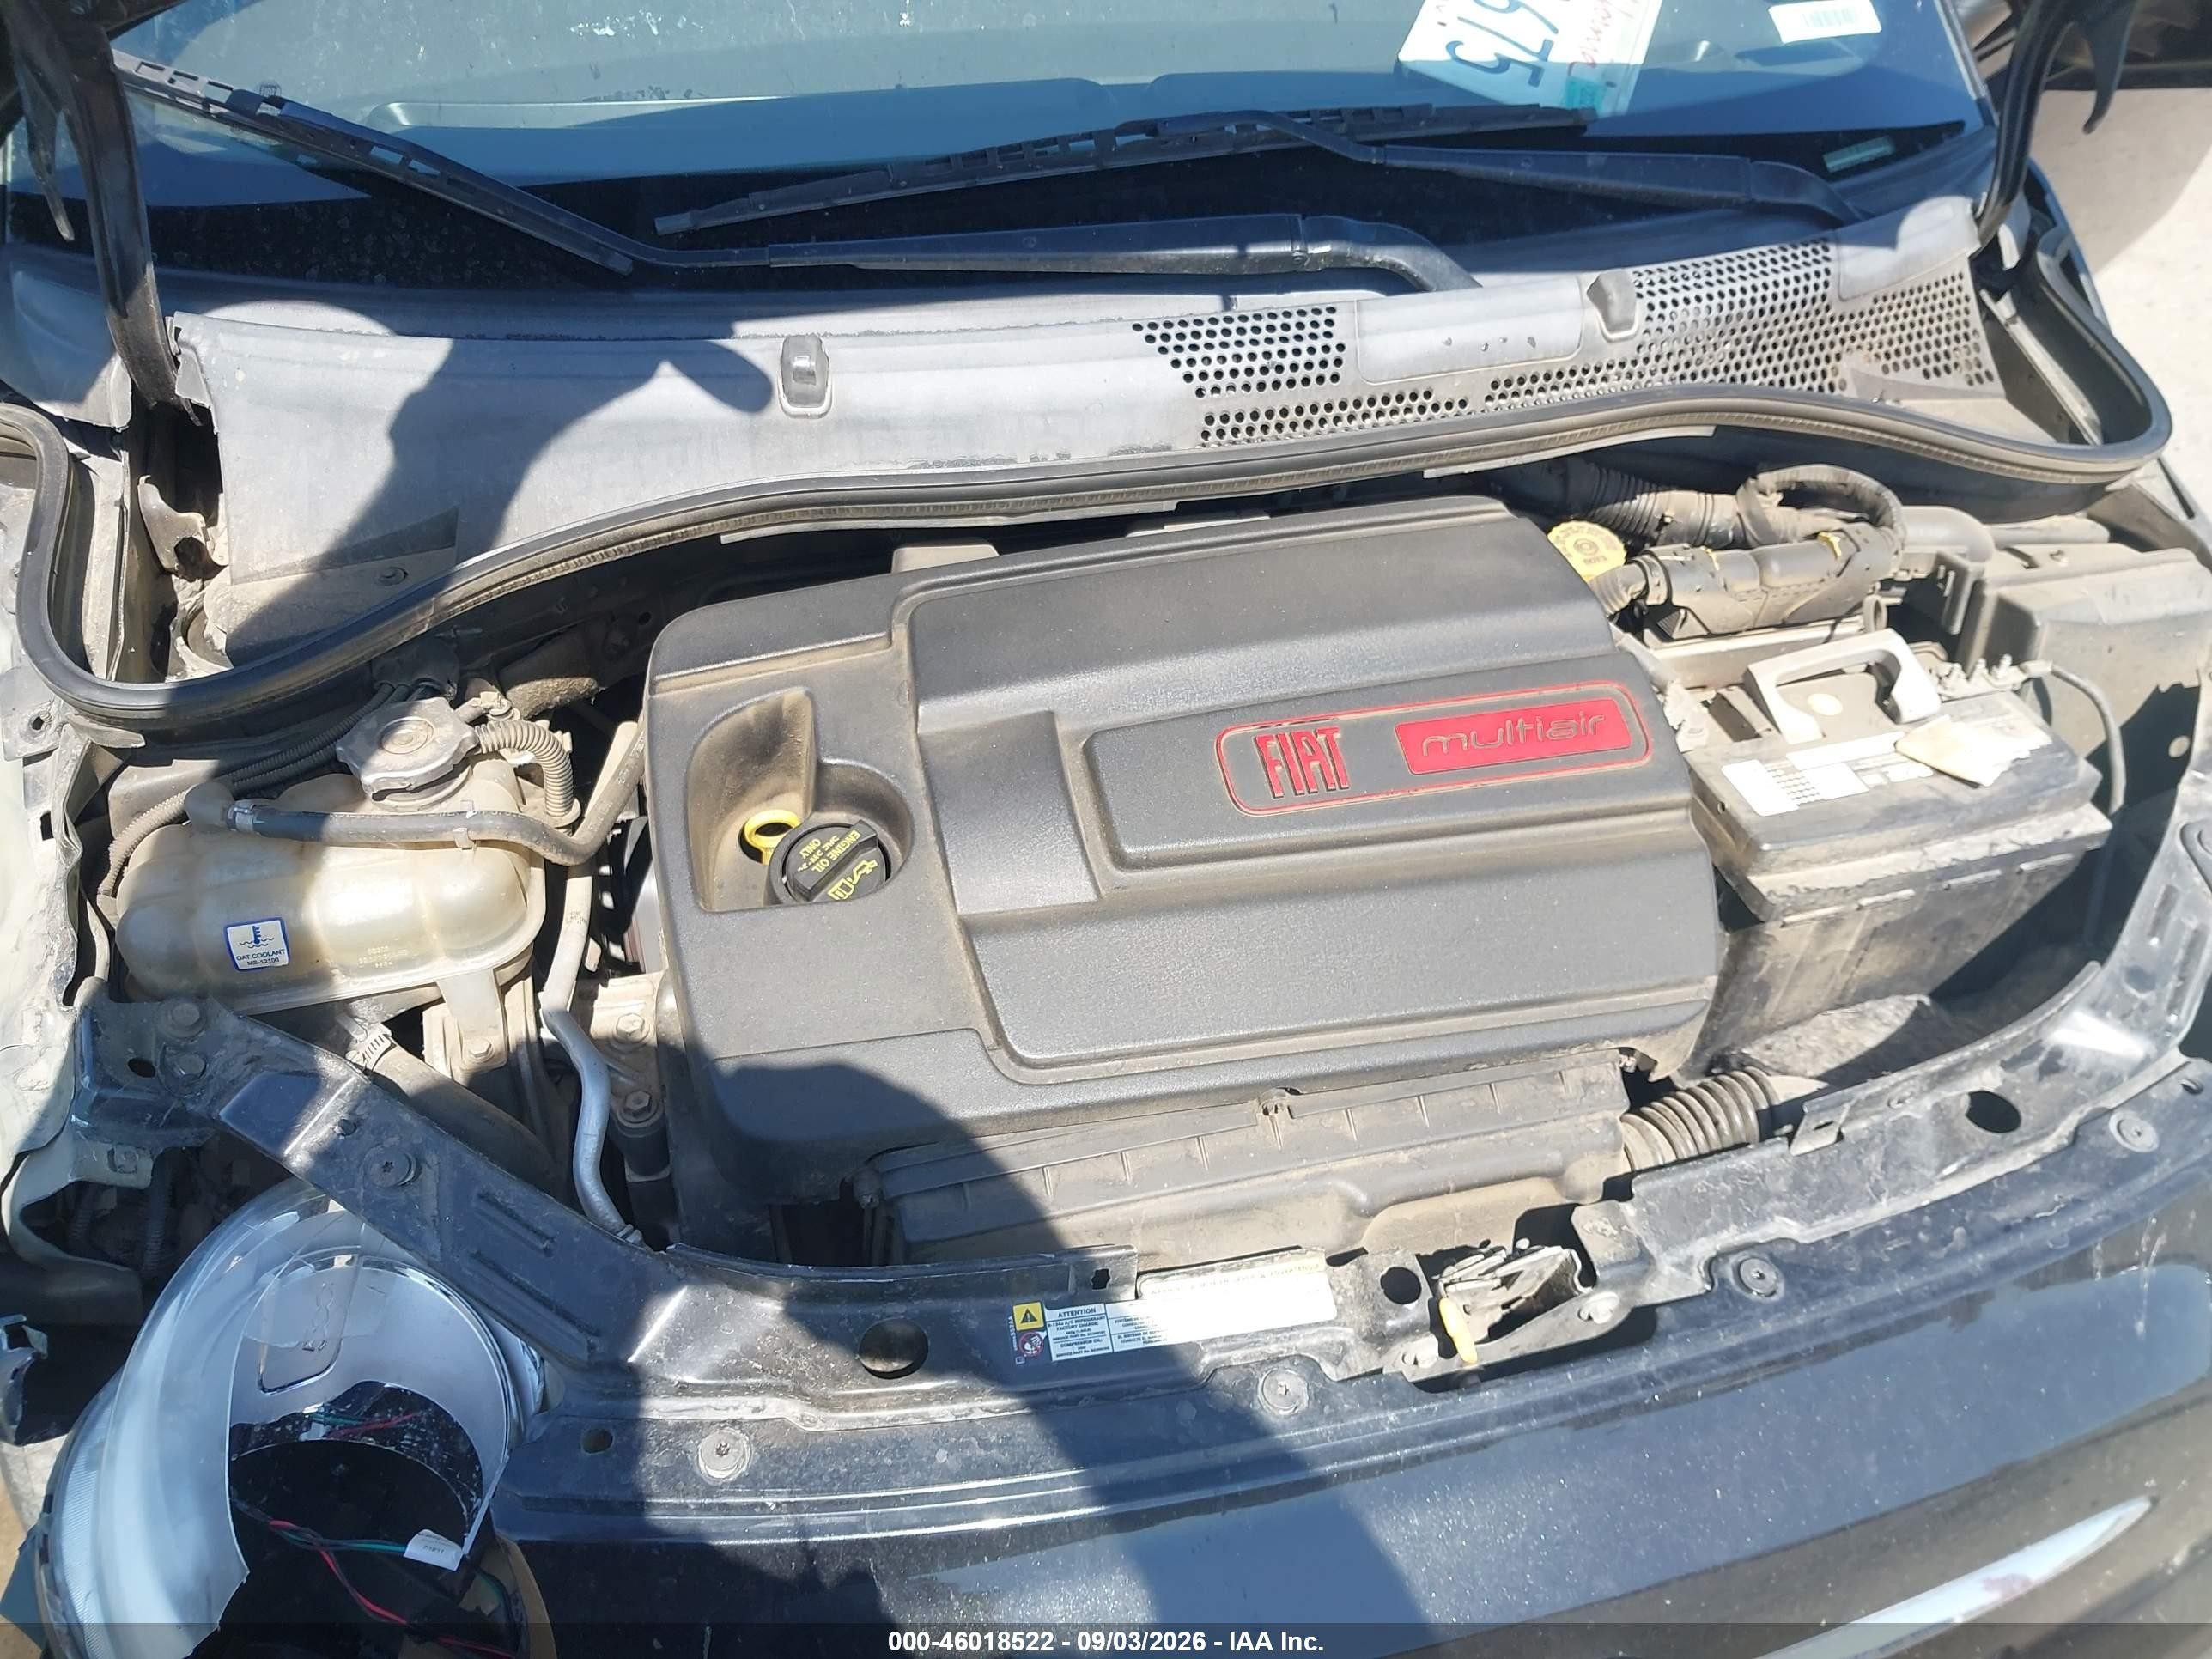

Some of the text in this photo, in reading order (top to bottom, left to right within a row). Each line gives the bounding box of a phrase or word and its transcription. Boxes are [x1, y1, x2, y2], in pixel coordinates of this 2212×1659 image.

[1252, 710, 1606, 799] FIAT multiair
[799, 838, 822, 859] ONLY
[811, 830, 860, 872] ENGINE OIL
[252, 949, 285, 959] COOLANT
[1058, 1308, 1097, 1318] ATTENTION
